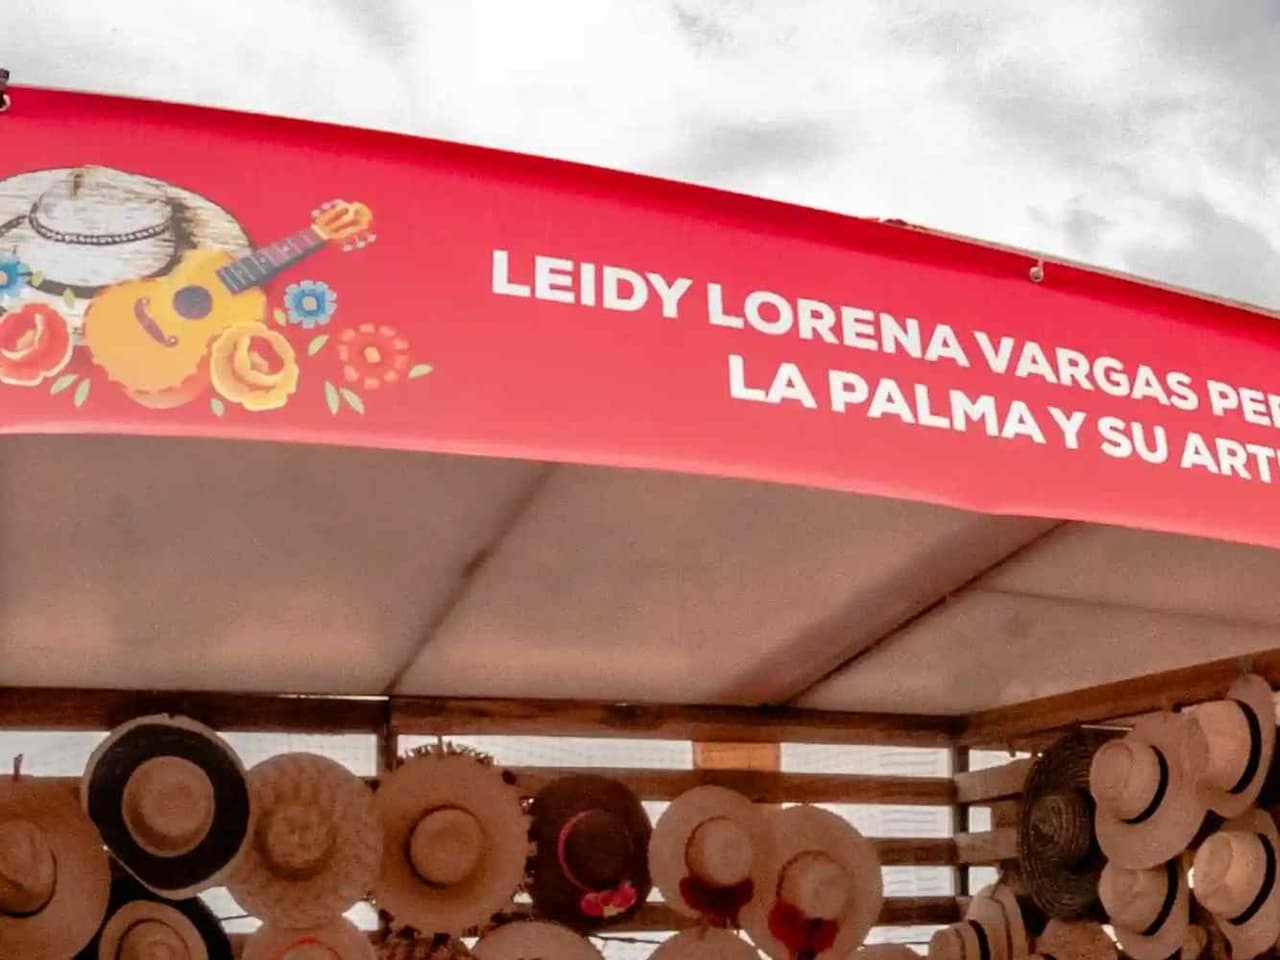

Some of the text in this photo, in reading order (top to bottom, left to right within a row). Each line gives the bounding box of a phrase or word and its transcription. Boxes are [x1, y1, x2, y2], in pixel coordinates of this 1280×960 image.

[492, 249, 693, 319] LEIDY
[706, 282, 970, 368] LORENA
[973, 331, 1199, 411] VARGAS
[728, 354, 818, 409] LA
[829, 369, 1046, 444] PALMA
[1047, 406, 1087, 449] Y
[1097, 416, 1169, 464] SU
